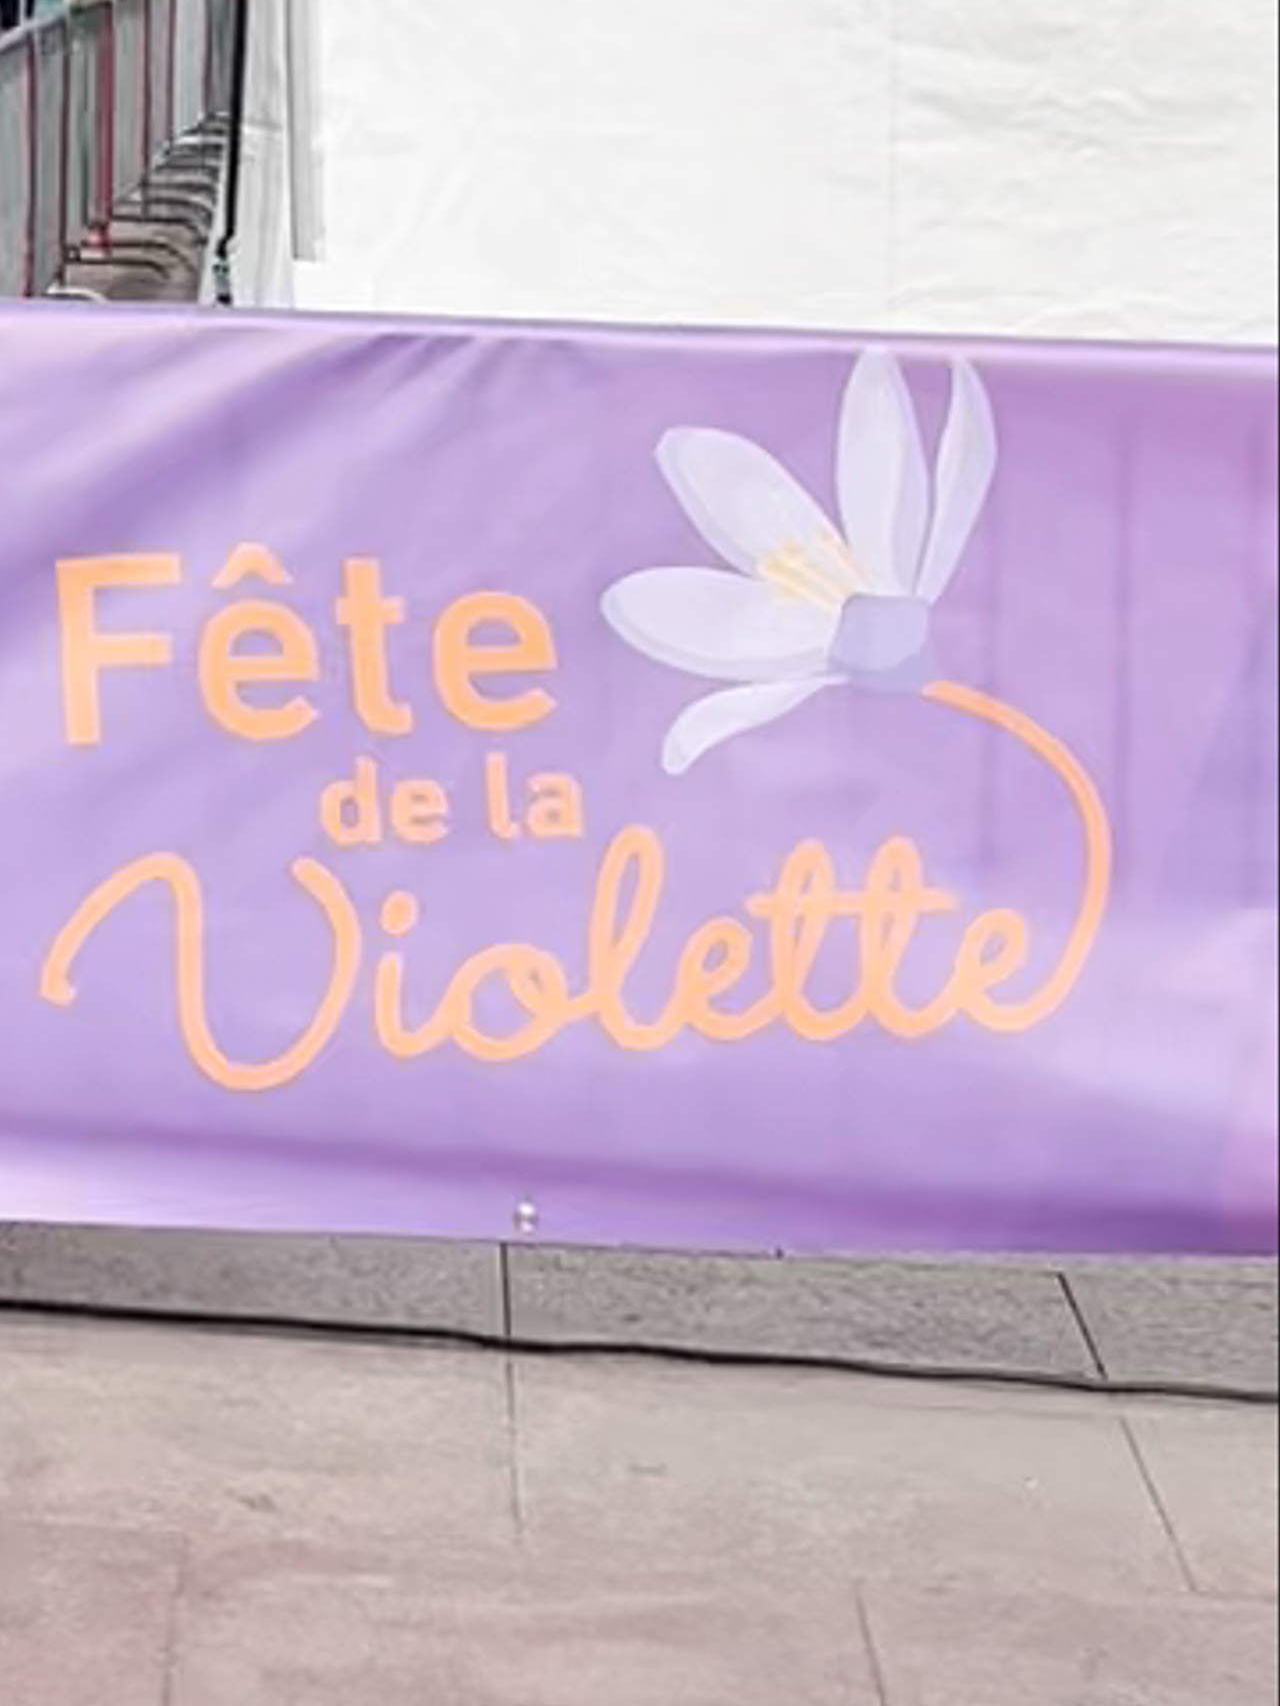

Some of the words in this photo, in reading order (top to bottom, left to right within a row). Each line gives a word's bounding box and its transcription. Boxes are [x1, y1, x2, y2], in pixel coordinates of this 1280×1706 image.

[53, 542, 559, 747] Fête
[318, 756, 450, 846] de
[484, 752, 585, 842] la
[38, 821, 1108, 1092] Violette
